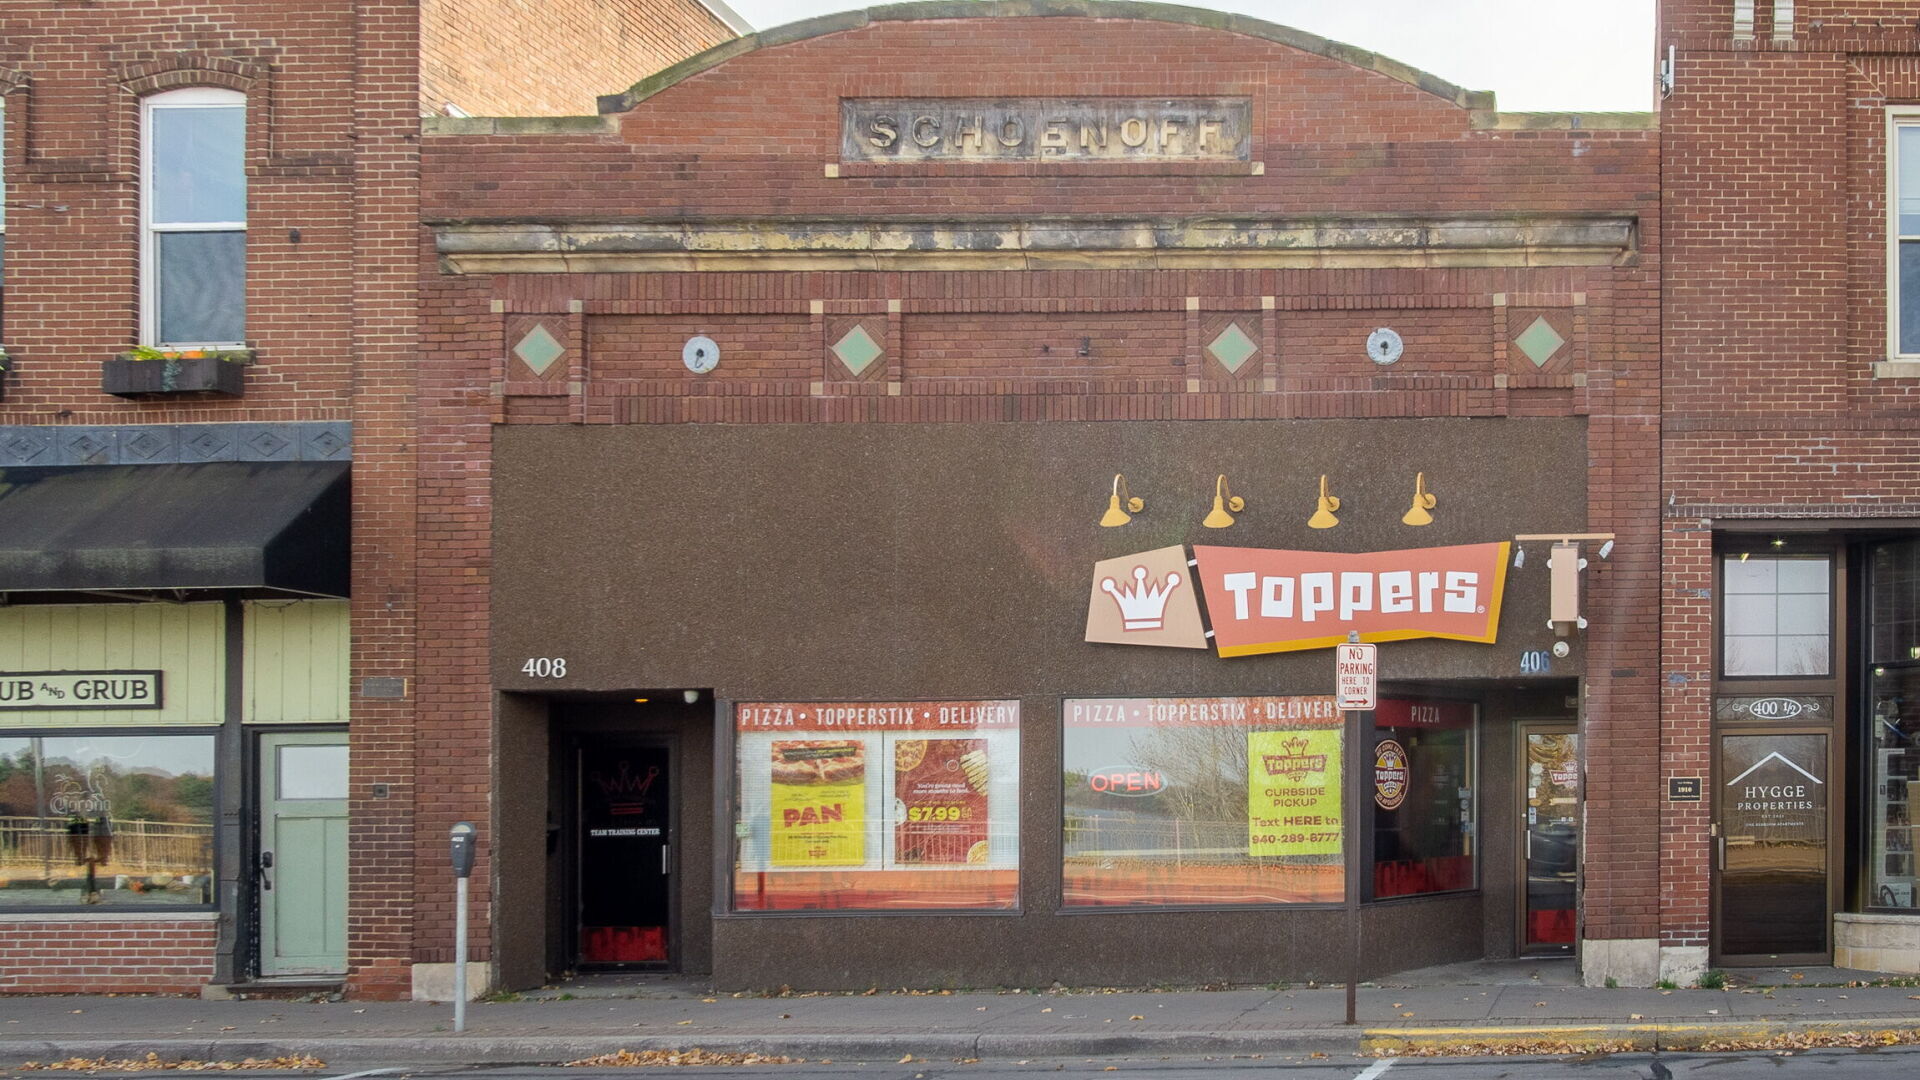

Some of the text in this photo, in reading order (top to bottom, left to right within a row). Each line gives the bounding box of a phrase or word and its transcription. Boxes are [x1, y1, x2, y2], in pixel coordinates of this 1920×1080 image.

[868, 115, 1225, 148] SCHOENOFF
[1223, 570, 1479, 622] Toppers
[1348, 647, 1364, 660] NO
[1520, 650, 1550, 672] 406
[521, 657, 567, 678] 408
[1339, 662, 1373, 675] PARKING
[1341, 676, 1370, 685] HERE TO
[73, 679, 149, 700] GRUB
[1344, 686, 1368, 695] CORNER
[1073, 704, 1126, 722] PIZZA
[1147, 703, 1246, 721] TOPPERSTIX
[1411, 705, 1440, 723] PIZZA
[1753, 701, 1778, 715] 400
[741, 706, 1016, 726] PIZZA TOPPERSTIX DELIVERY
[1265, 757, 1325, 774] Toppers
[1091, 772, 1162, 792] OPEN
[1376, 770, 1404, 781] Toppers
[1264, 787, 1325, 797] CURBSIDE
[1745, 785, 1805, 798] HYGGE
[50, 795, 112, 815] Corona
[1273, 798, 1318, 808] PICKUP
[1737, 801, 1813, 810] PROPERTIES
[783, 803, 842, 828] PAN
[908, 806, 961, 821] $7.99
[1251, 815, 1339, 827] Text HERE to
[608, 828, 636, 836] TRAINING
